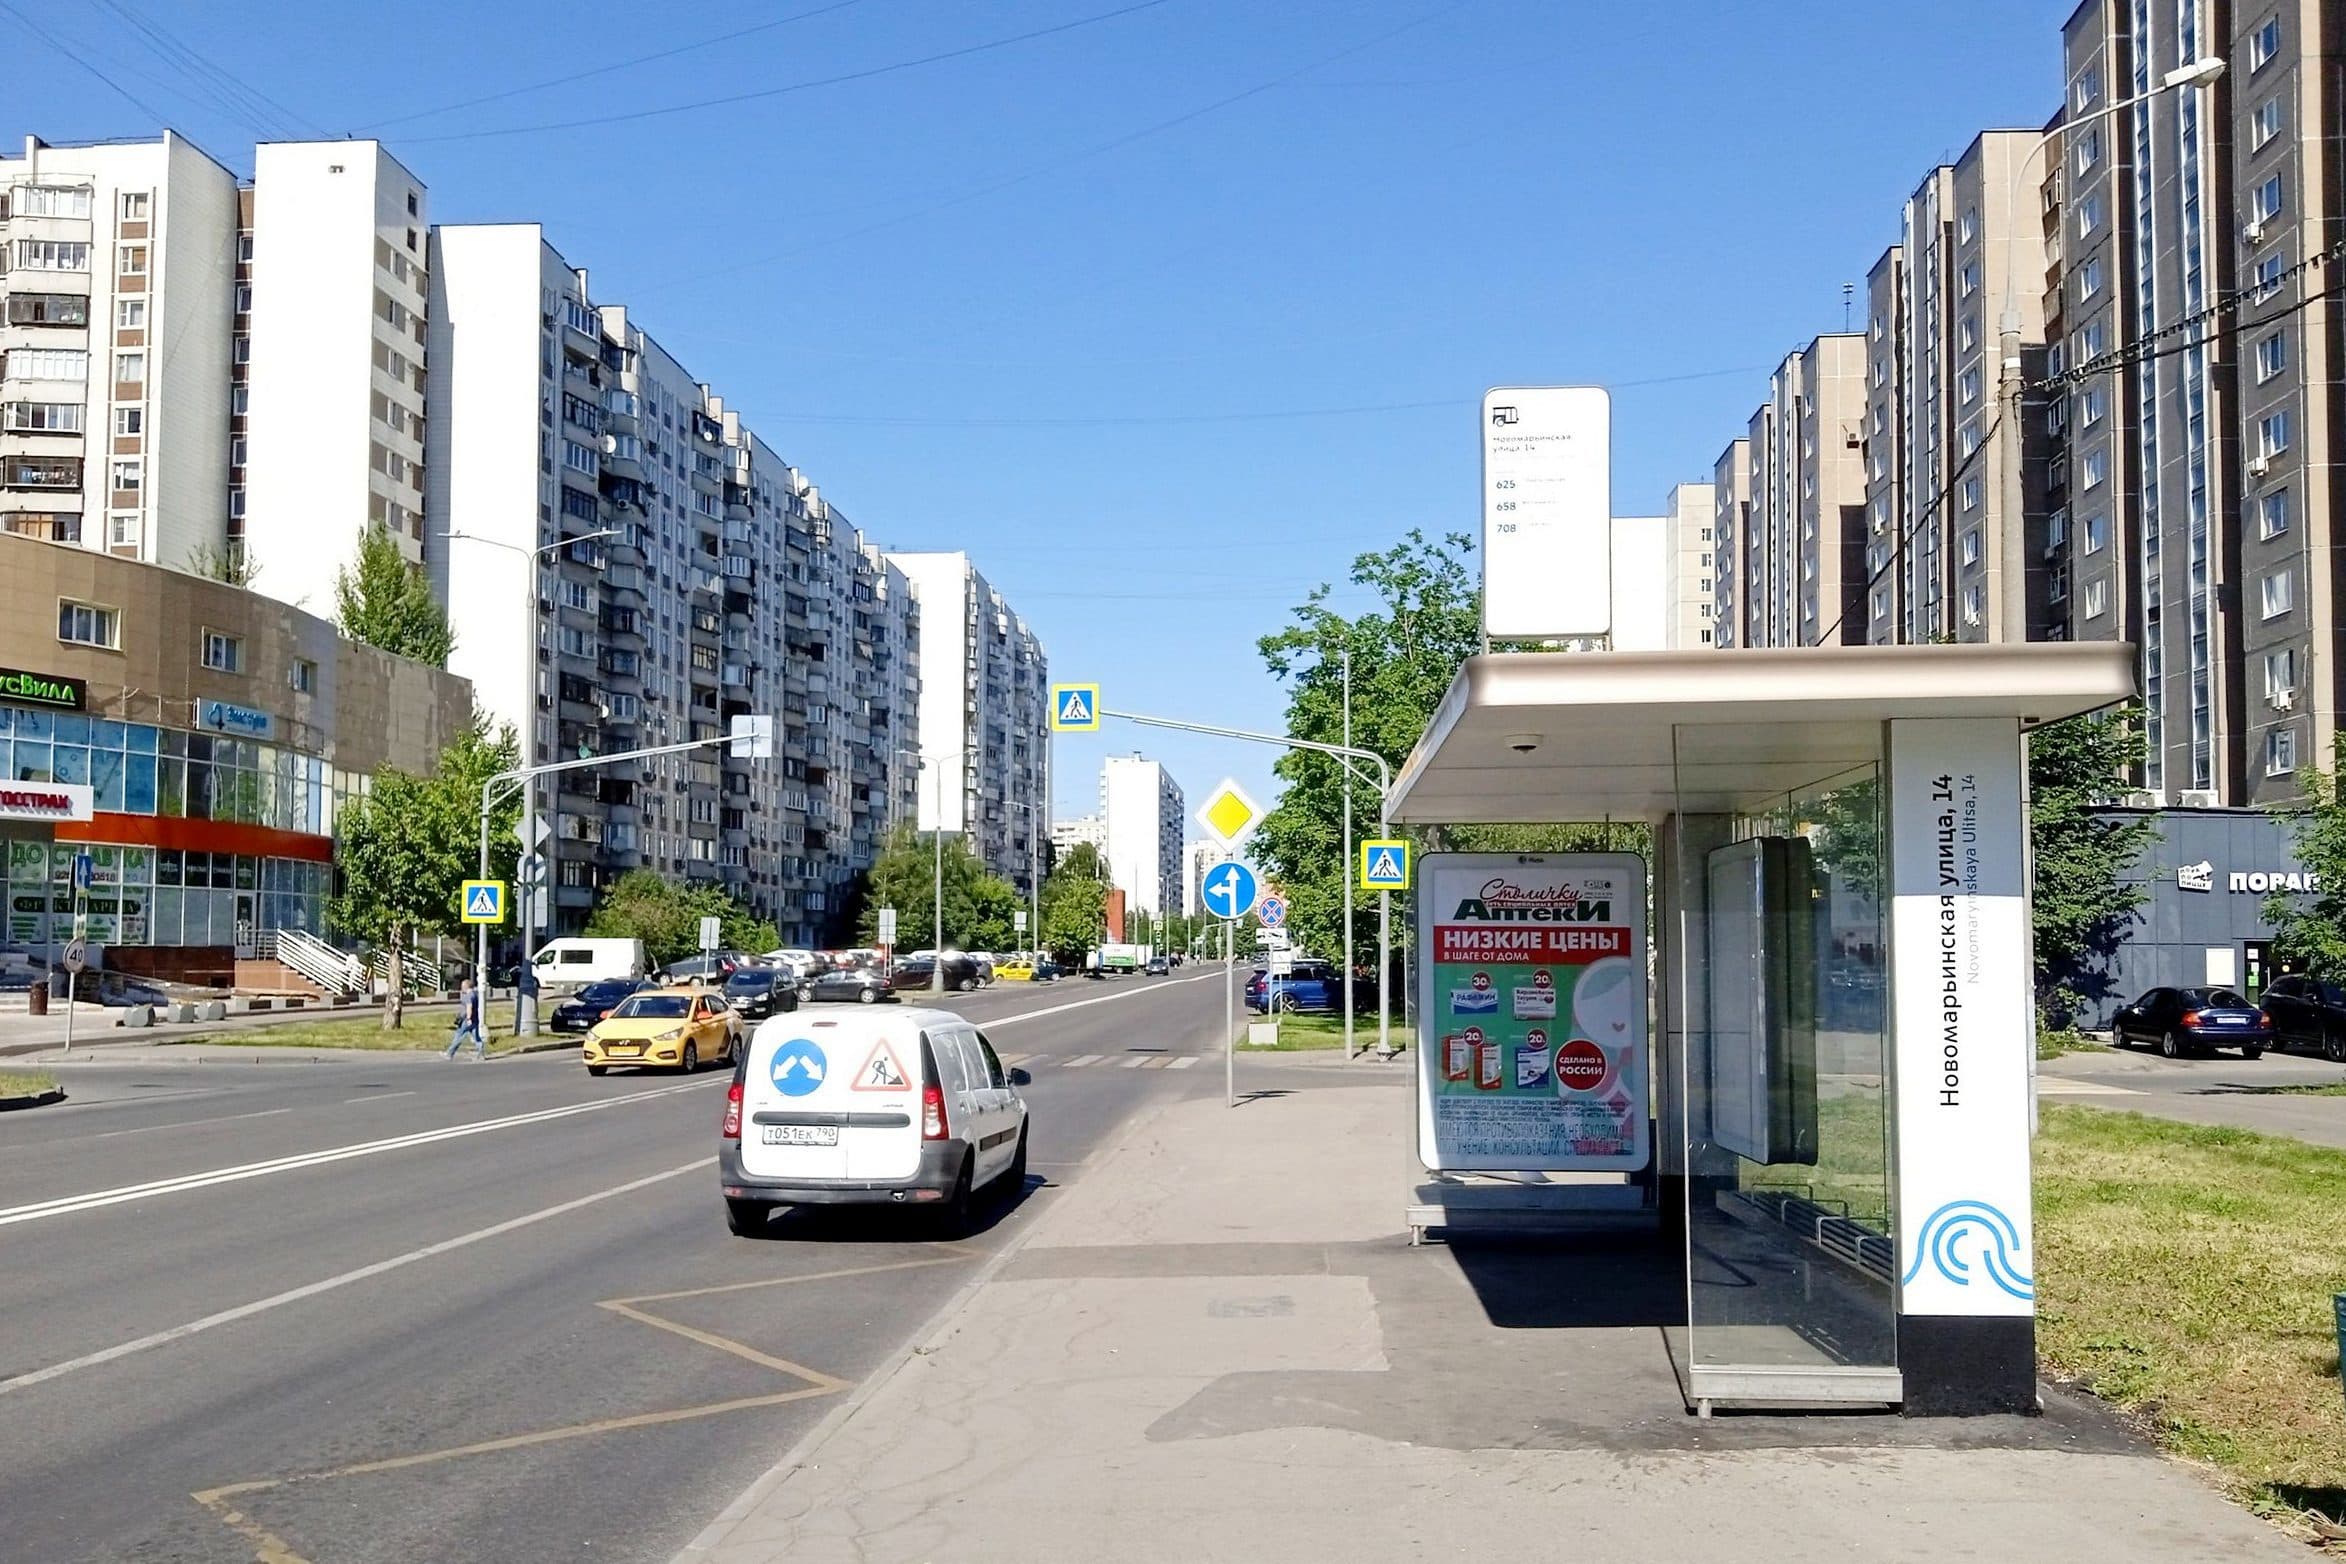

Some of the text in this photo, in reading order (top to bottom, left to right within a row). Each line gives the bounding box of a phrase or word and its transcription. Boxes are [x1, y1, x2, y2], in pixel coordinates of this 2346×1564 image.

[1496, 480, 1516, 489] 625
[1496, 502, 1517, 511] 658
[1496, 524, 1517, 533] 708
[1961, 774, 1976, 792] 14
[1961, 796, 1978, 843] Ulitsa,
[1444, 931, 1619, 952] НИЗКИЕ ЦЕНЫ
[1933, 774, 1962, 1107] Новомарьинская улица, 14
[69, 949, 83, 960] 40
[1444, 951, 1530, 962] В ШАГЕ ОТ ДОМА
[1559, 1057, 1596, 1065] СДЕЛАНО
[1559, 1066, 1603, 1076] РОССИИ
